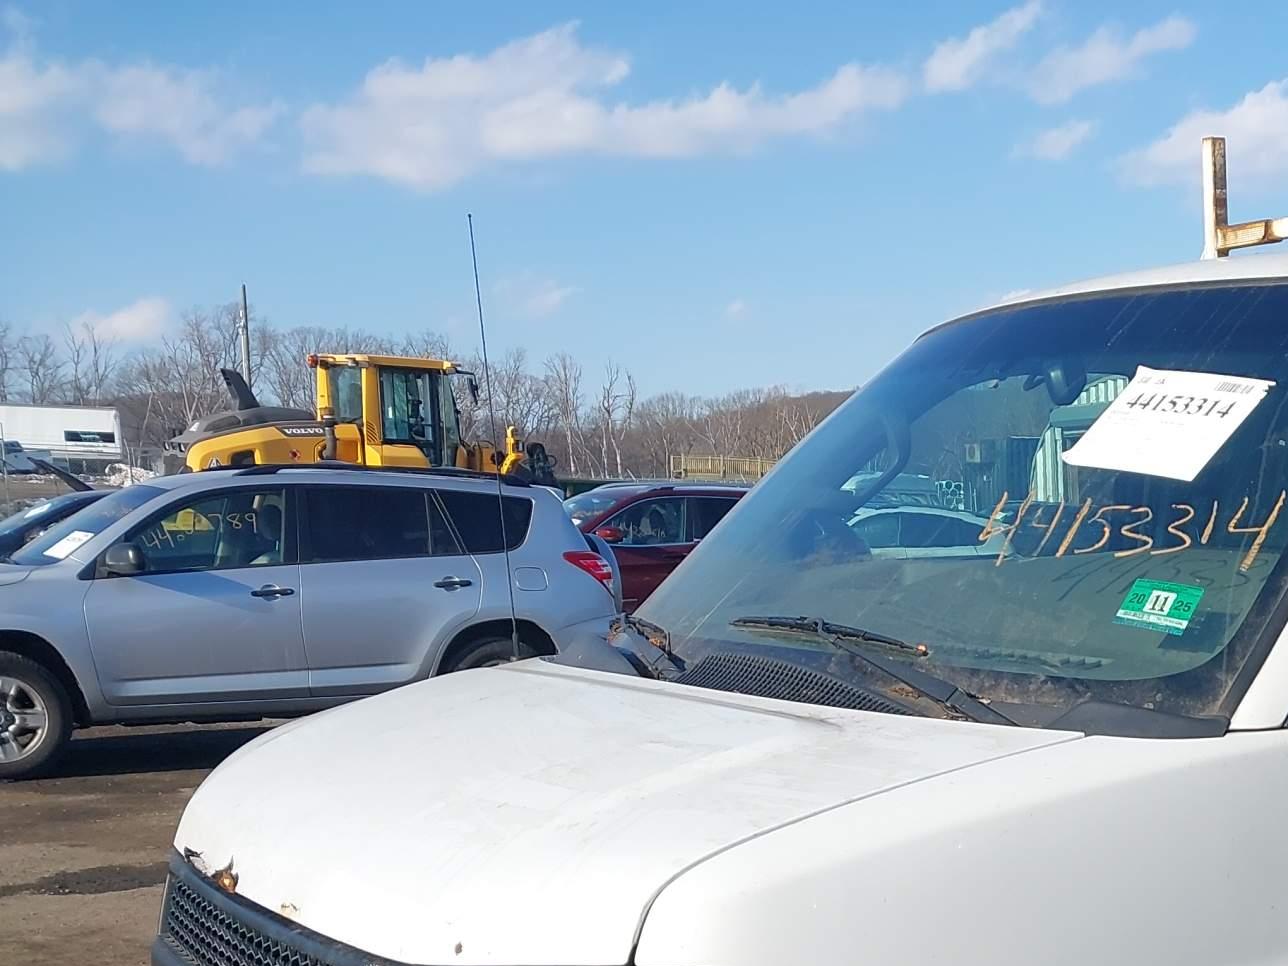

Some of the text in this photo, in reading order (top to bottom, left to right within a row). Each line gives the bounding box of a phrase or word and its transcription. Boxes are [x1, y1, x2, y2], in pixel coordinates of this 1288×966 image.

[1126, 392, 1237, 418] 44153314
[978, 488, 1286, 572] 44153314
[1128, 593, 1193, 613] 20 11 25
